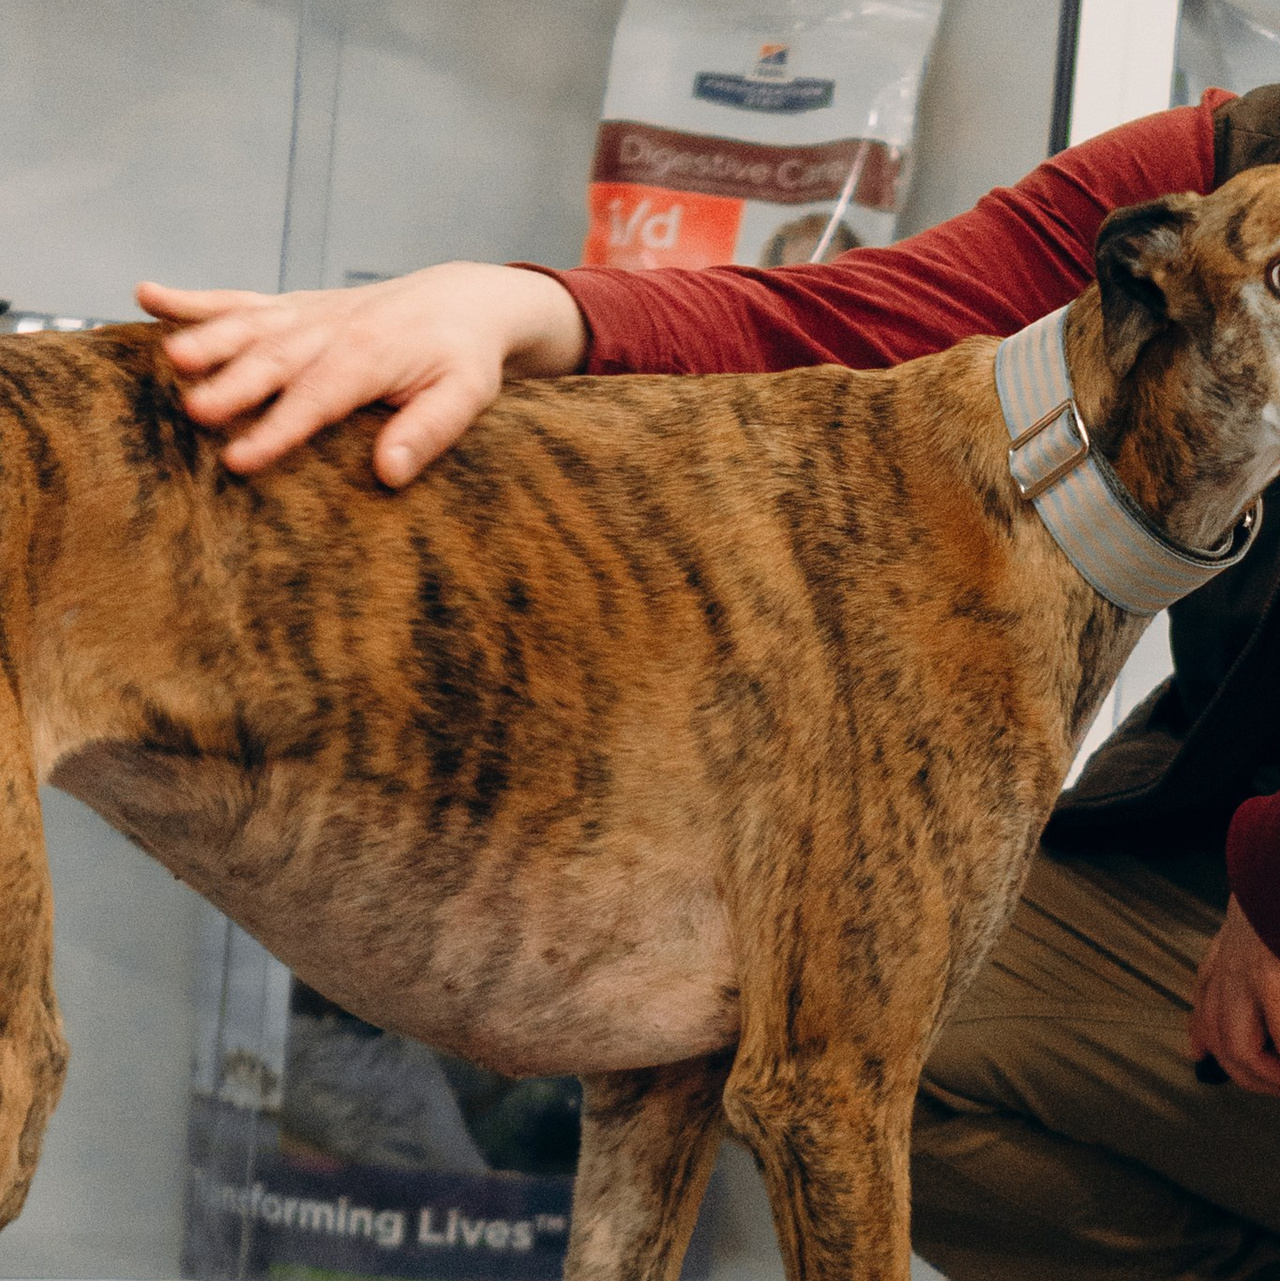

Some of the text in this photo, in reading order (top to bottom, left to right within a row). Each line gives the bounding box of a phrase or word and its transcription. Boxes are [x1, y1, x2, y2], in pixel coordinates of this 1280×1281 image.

[621, 135, 850, 188] Digestive Care
[609, 197, 683, 249] i/d
